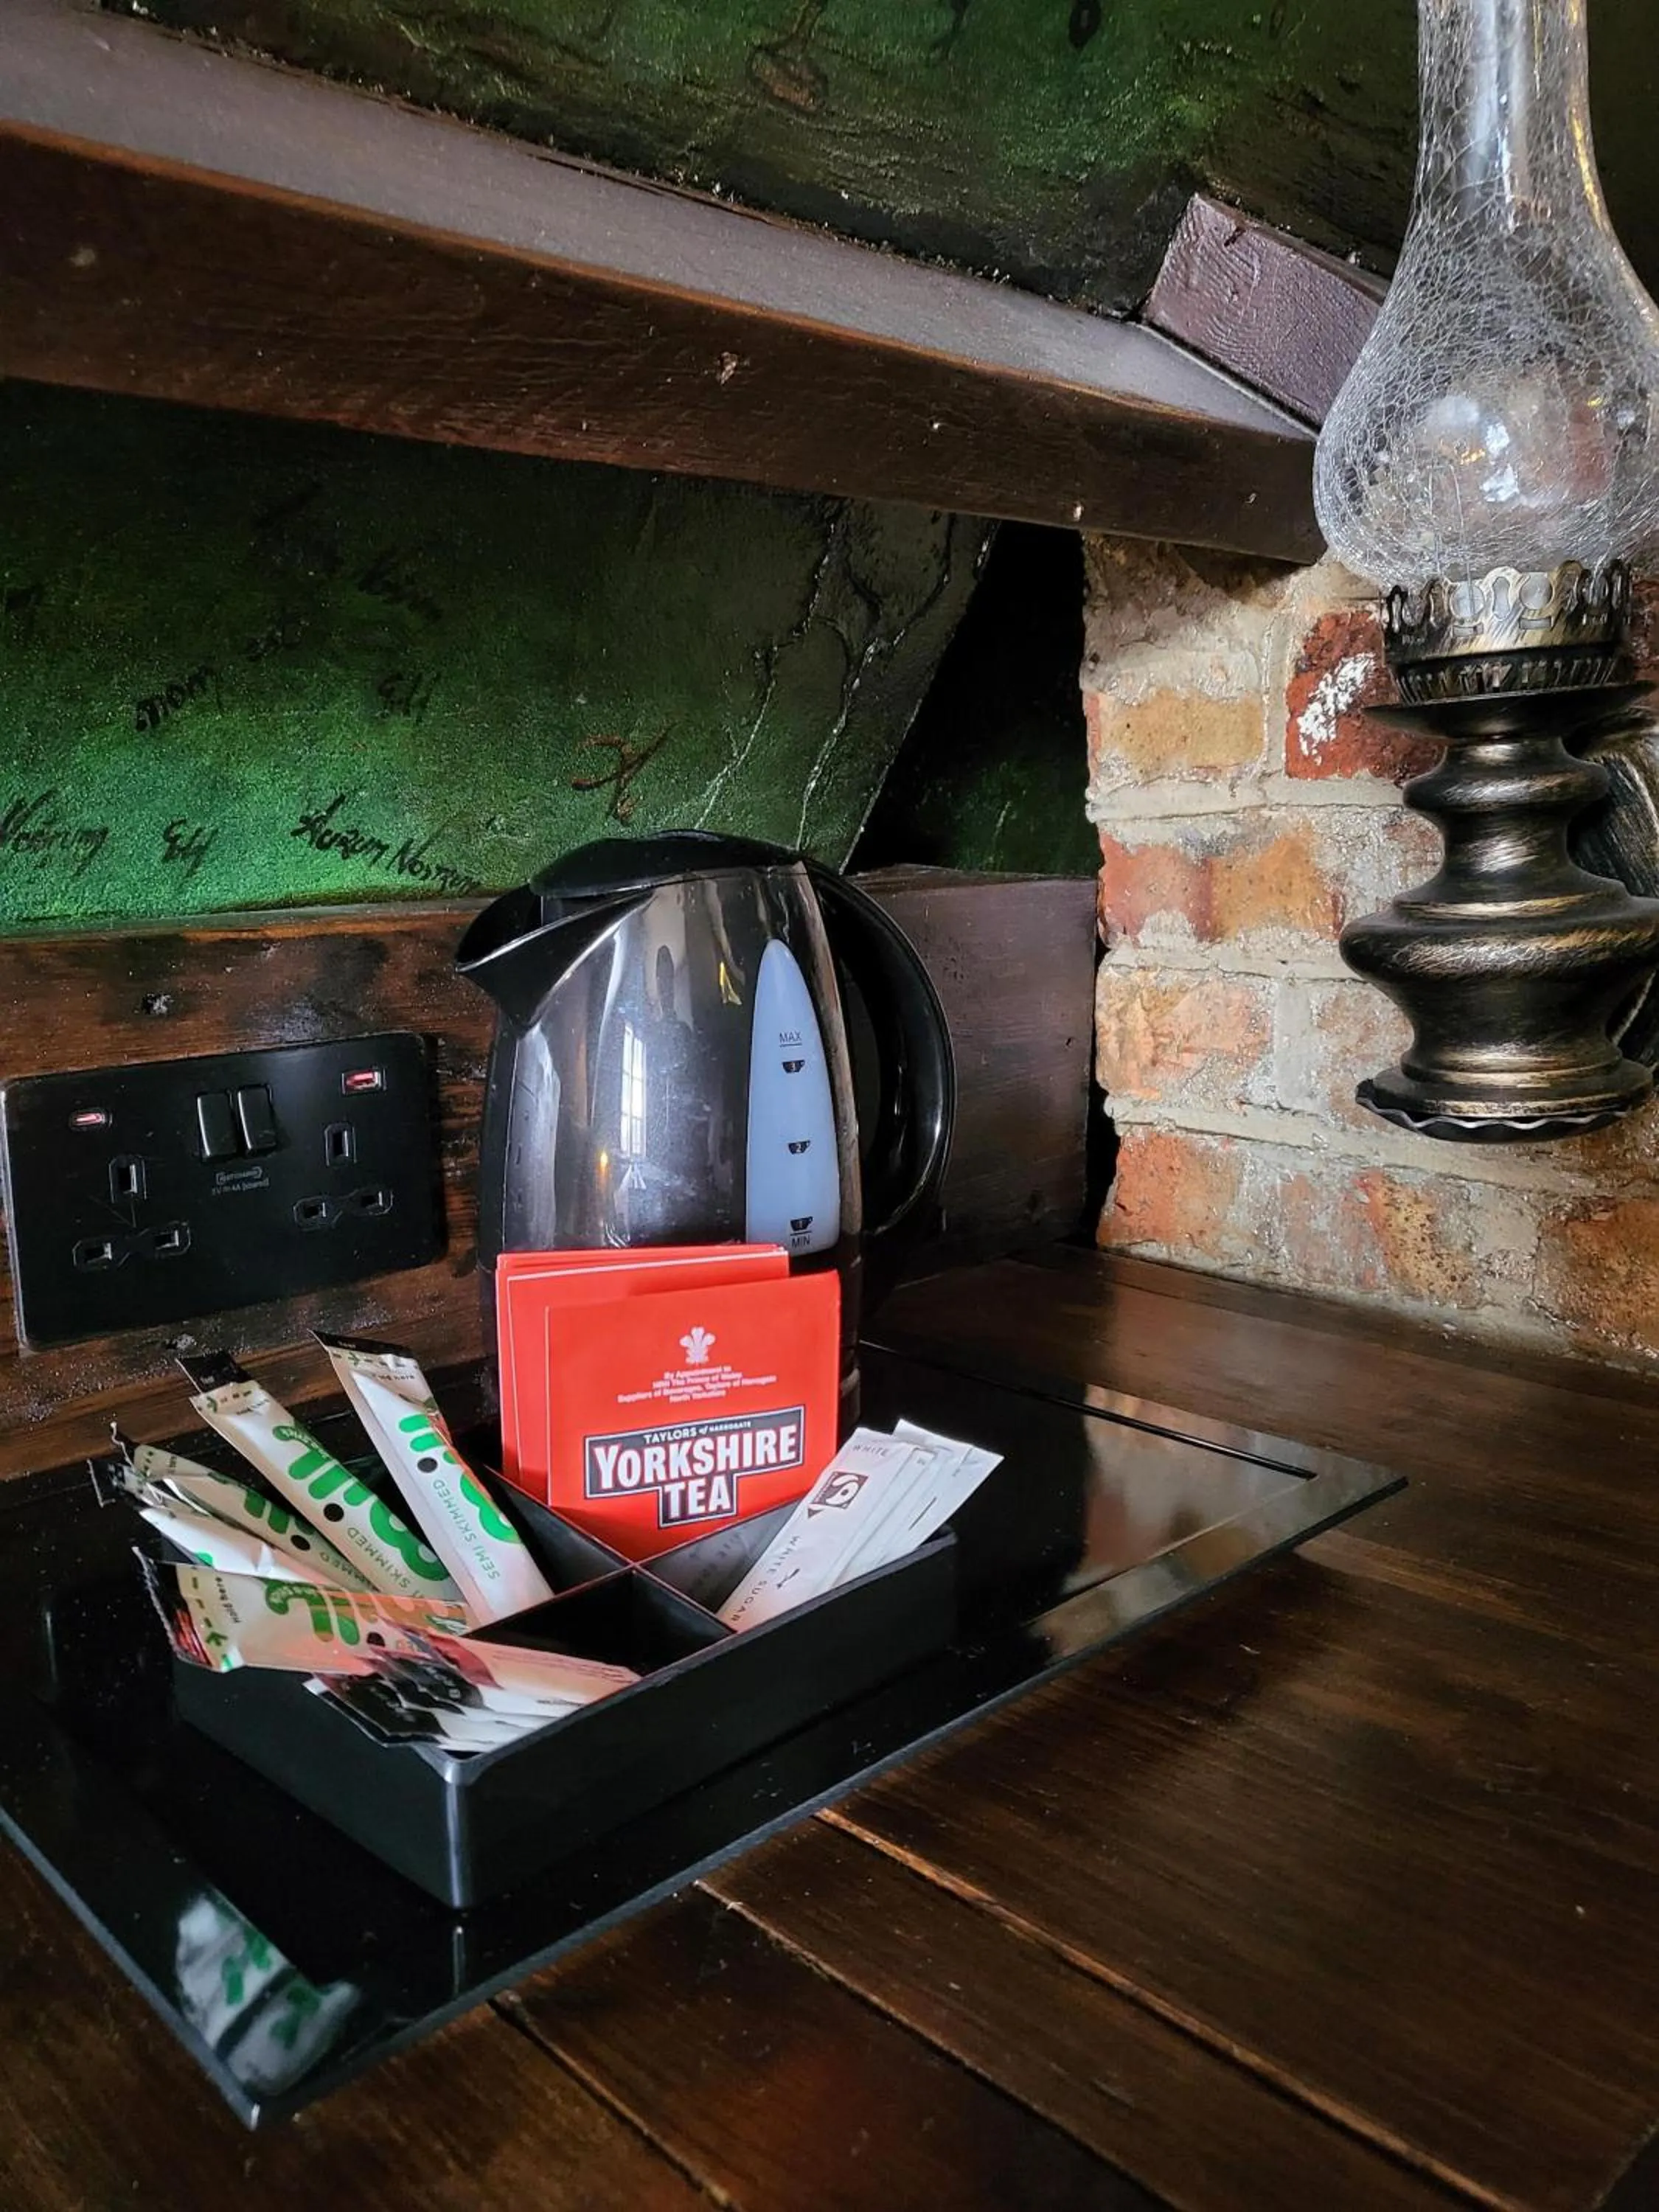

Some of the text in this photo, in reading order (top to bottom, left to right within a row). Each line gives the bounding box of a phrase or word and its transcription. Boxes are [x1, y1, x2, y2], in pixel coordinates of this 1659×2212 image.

[779, 1032, 802, 1043] MAX
[791, 1236, 811, 1248] MIN
[643, 1427, 697, 1444] TAYLORS
[594, 1425, 798, 1491] YORKSHIRE
[664, 1474, 732, 1520] TEA
[432, 1478, 501, 1581] SEMI SKIMMED
[347, 1526, 413, 1588] SKIMMED
[731, 1579, 768, 1622] SUGAR
